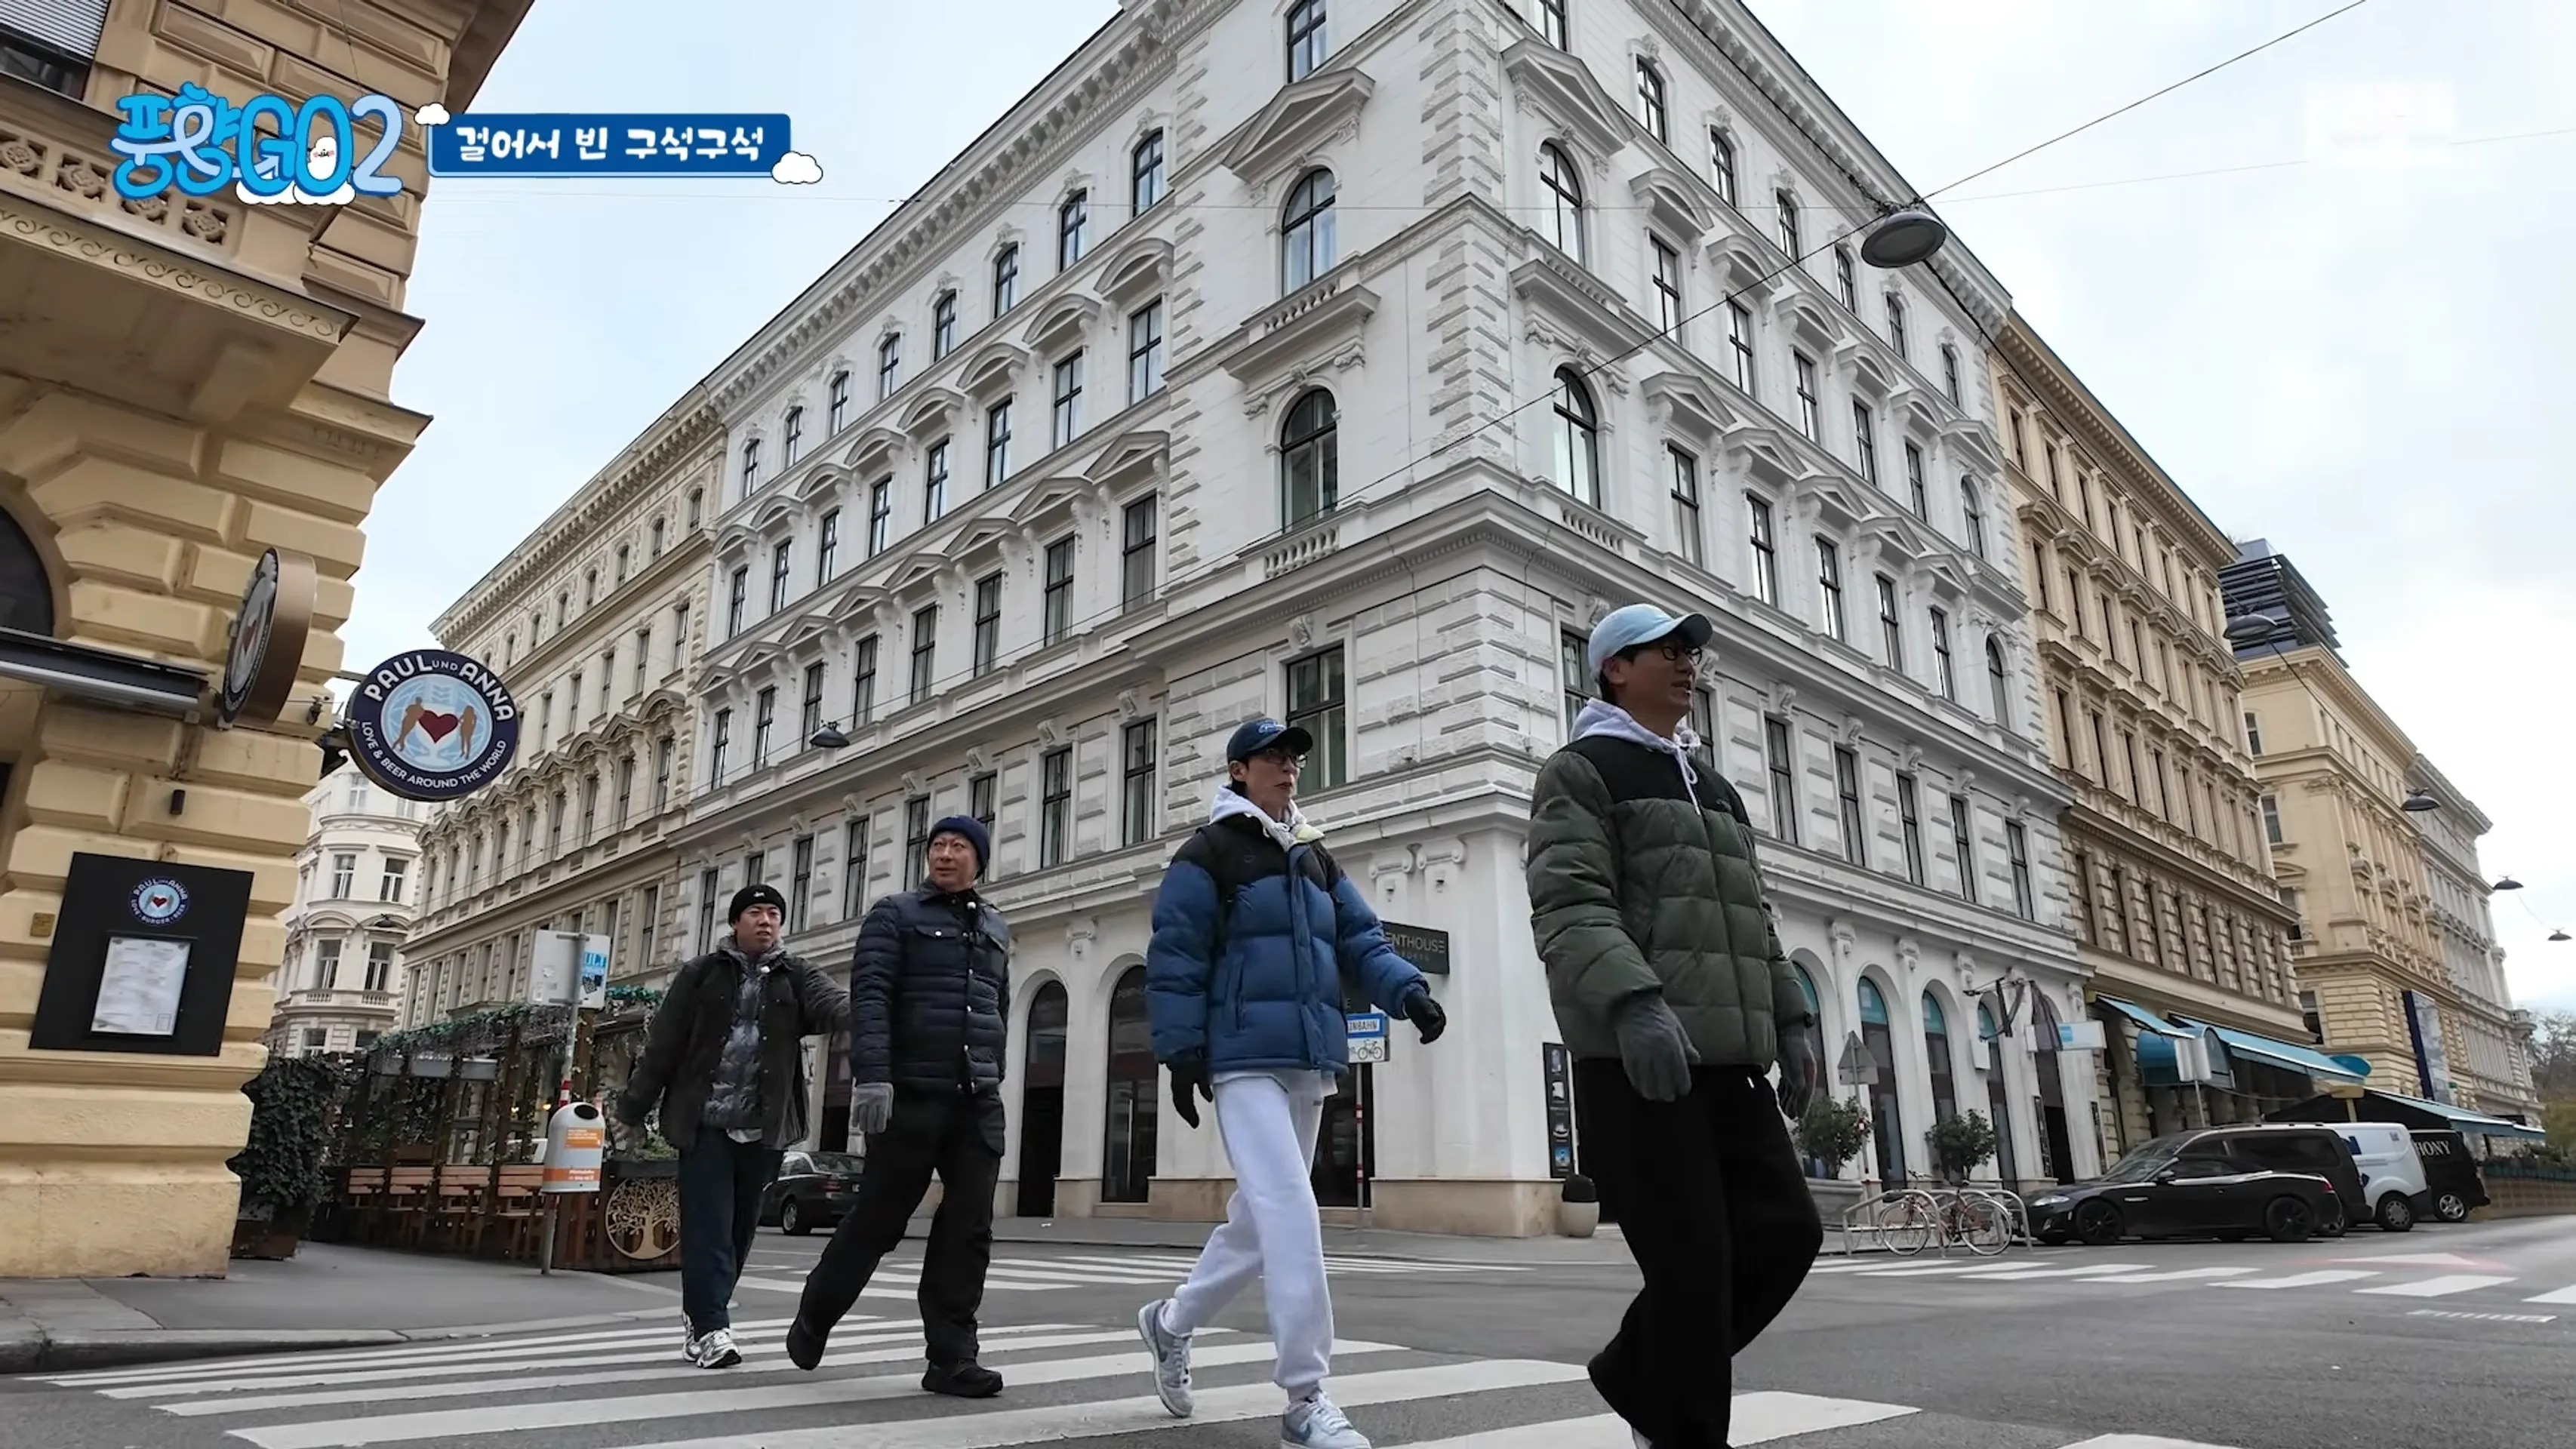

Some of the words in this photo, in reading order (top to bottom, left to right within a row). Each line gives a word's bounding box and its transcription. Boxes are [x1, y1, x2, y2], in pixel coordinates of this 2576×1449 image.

[364, 654, 432, 702] PAUL
[432, 660, 458, 671] UND
[459, 662, 515, 721] ANNA
[362, 721, 379, 750] LOVE
[373, 749, 383, 759] &
[380, 757, 408, 780] BEER
[407, 775, 459, 789] AROUND
[459, 768, 482, 785] THE
[479, 740, 507, 775] WORLD
[133, 878, 157, 896] PAUL
[1384, 932, 1445, 953] ENTHOUSE
[1349, 1020, 1378, 1032] INBAHN
[2416, 1140, 2451, 1156] HONY
